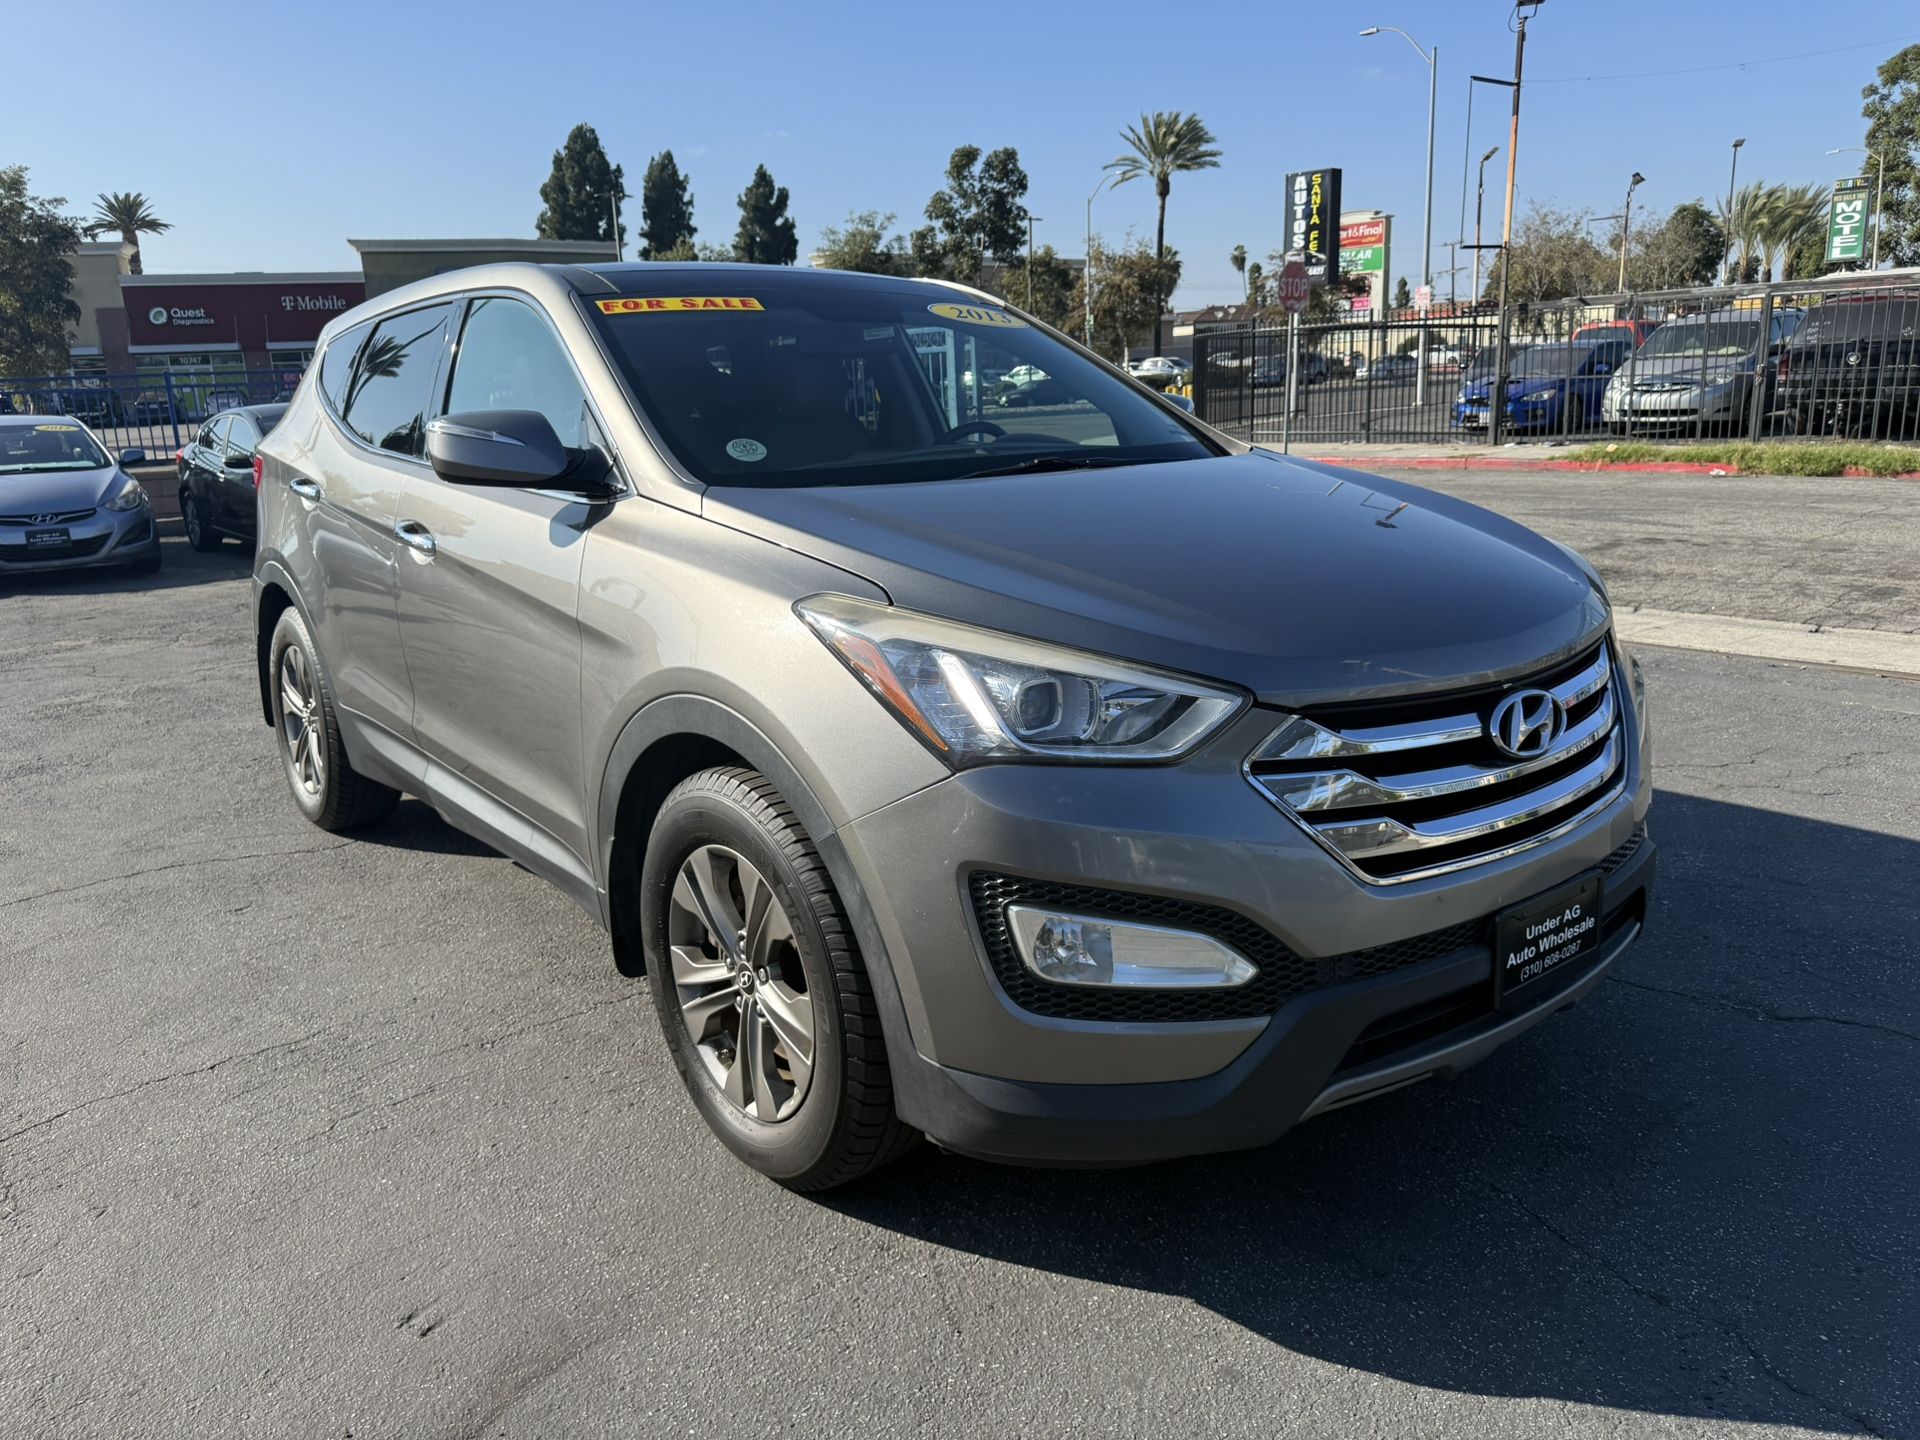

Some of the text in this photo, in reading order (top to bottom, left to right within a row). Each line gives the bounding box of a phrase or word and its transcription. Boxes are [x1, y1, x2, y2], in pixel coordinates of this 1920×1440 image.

[1293, 175, 1307, 248] AUTOS
[1309, 173, 1321, 251] SANTA FE
[1832, 200, 1862, 258] MOTEL
[1339, 249, 1372, 262] OLLAR
[1279, 277, 1309, 297] STOP
[171, 308, 206, 317] Quest
[602, 298, 759, 312] FOR SALE
[948, 306, 1012, 324] 2013
[1526, 904, 1581, 940] Under AG
[1506, 916, 1595, 969] Auto Wholesale
[1521, 959, 1543, 982] (310)
